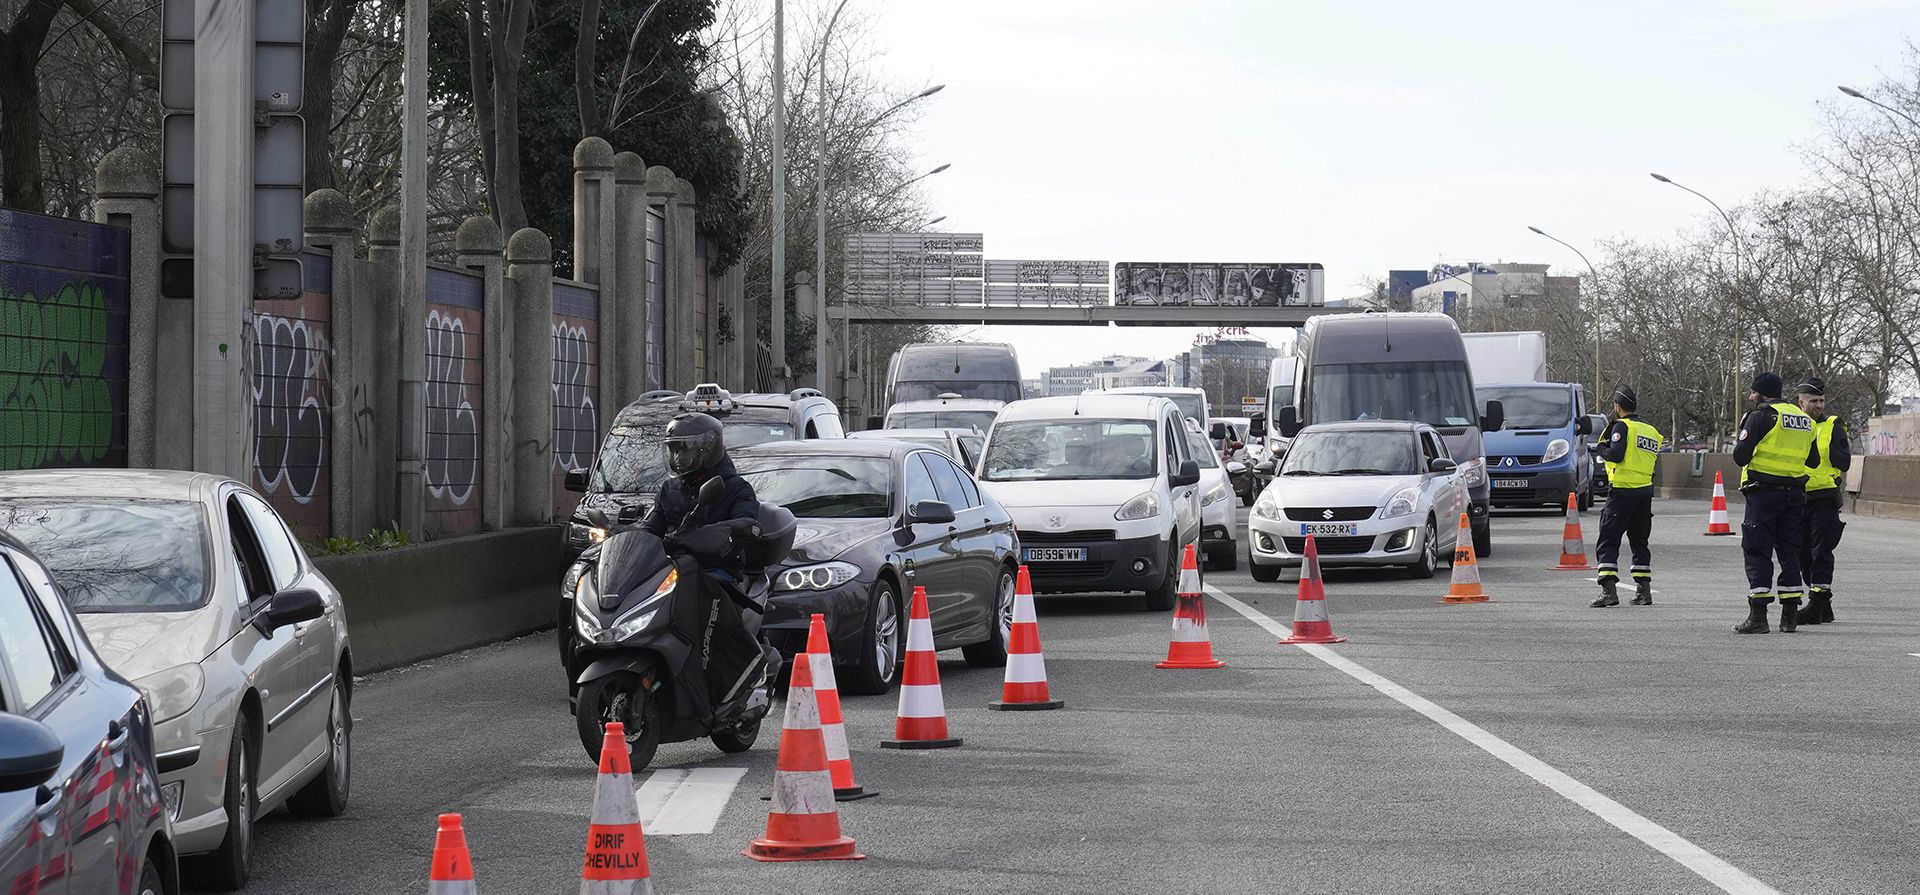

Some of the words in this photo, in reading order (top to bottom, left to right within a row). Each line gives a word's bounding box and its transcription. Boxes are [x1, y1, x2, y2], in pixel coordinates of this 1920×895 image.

[697, 387, 718, 395] TAXI
[1783, 415, 1811, 430] POLICE
[1637, 436, 1658, 452] POLICE
[594, 833, 625, 849] DIRIF
